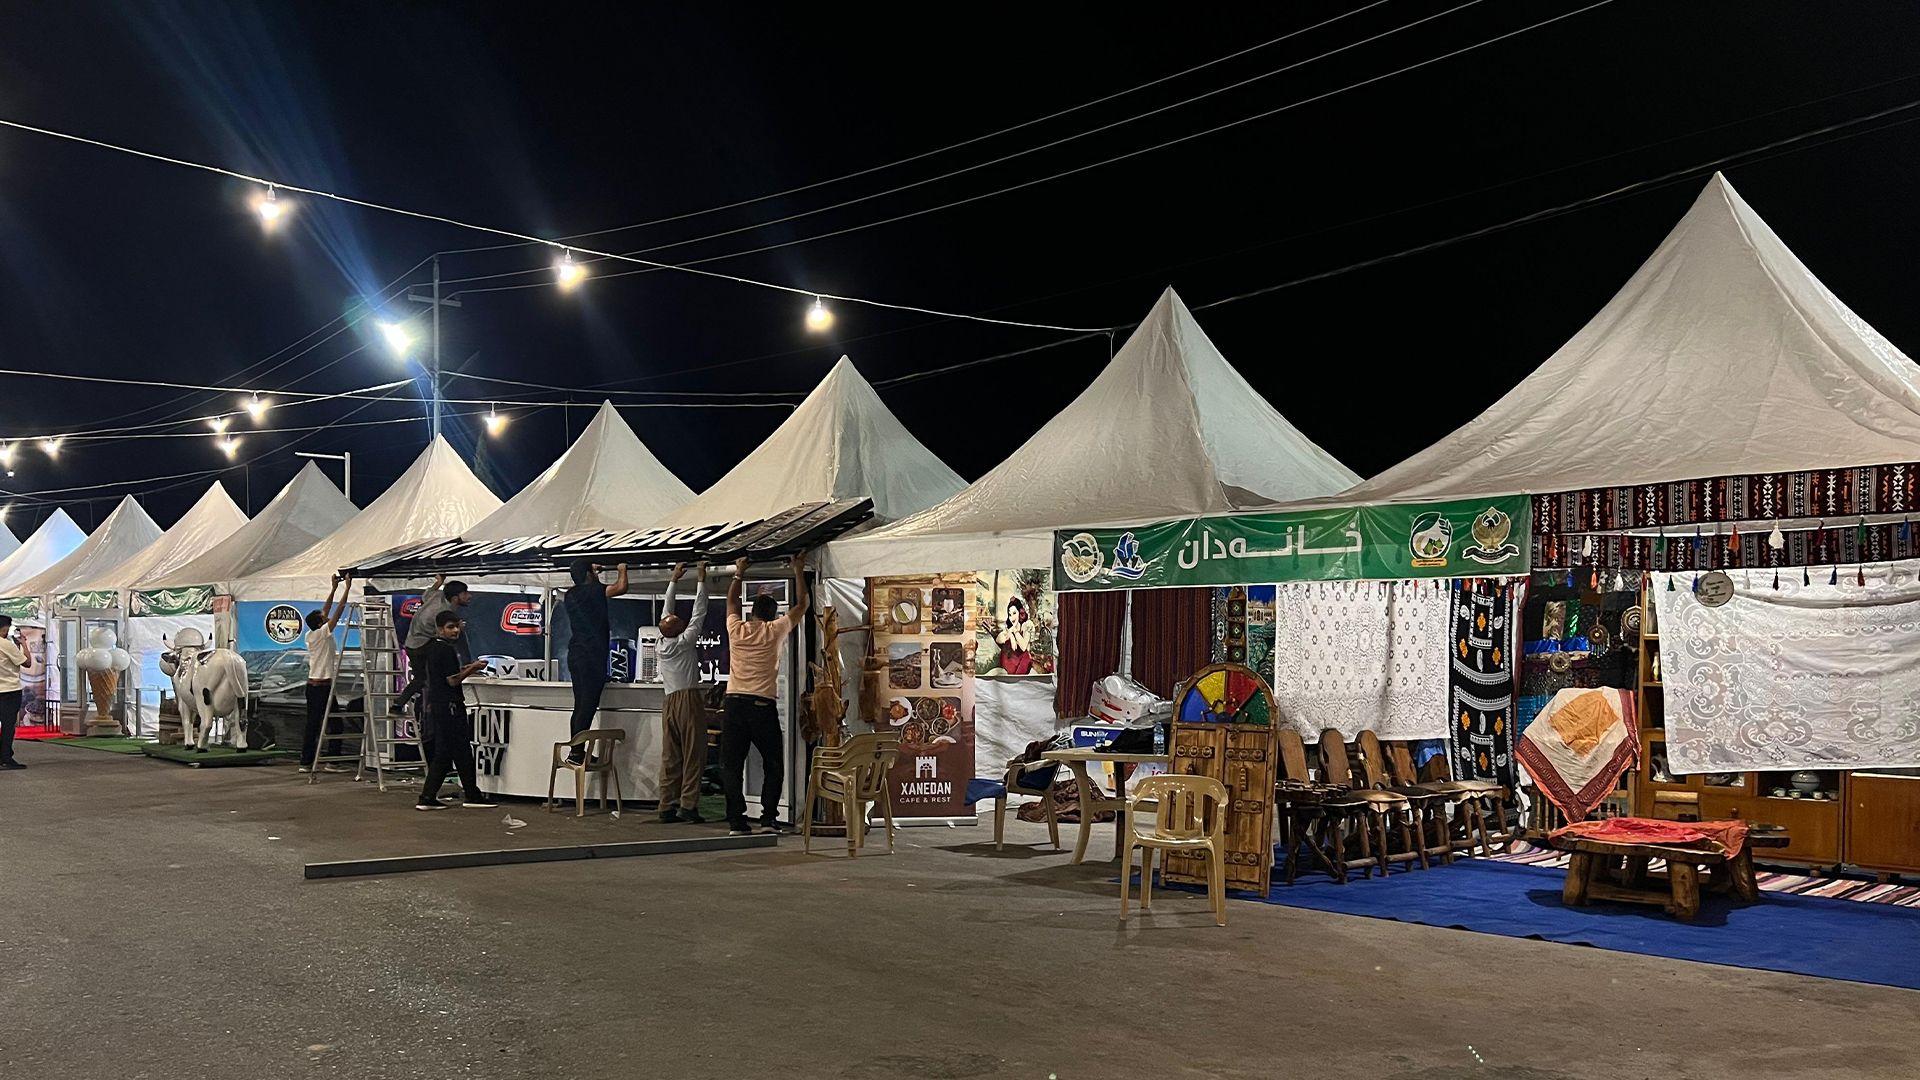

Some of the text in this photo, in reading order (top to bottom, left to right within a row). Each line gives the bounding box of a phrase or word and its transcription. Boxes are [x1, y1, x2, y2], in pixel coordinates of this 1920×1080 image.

[562, 519, 756, 551] ENERGY
[470, 709, 509, 744] ION
[901, 781, 952, 796] XANEDAN
